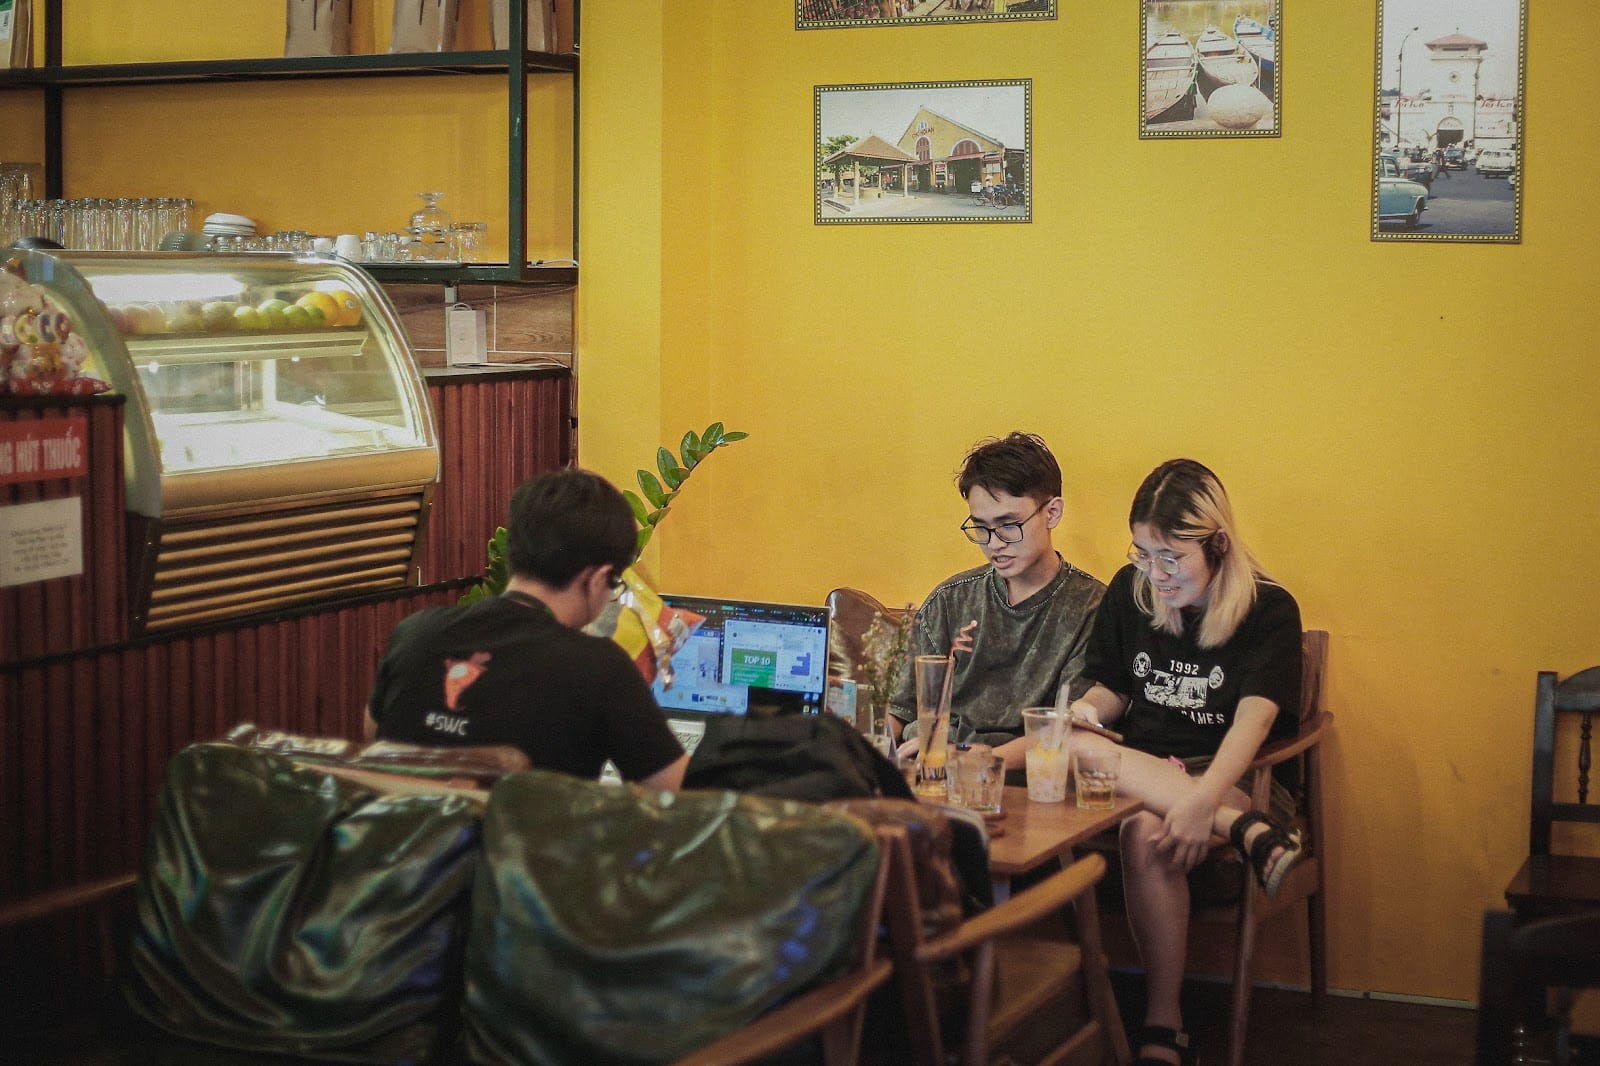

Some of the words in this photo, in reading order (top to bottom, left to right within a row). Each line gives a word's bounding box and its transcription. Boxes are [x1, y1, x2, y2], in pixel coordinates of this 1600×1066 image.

[743, 655, 760, 665] TOP
[761, 656, 771, 666] 10
[1170, 660, 1199, 675] 1992
[425, 712, 469, 736] #SWC
